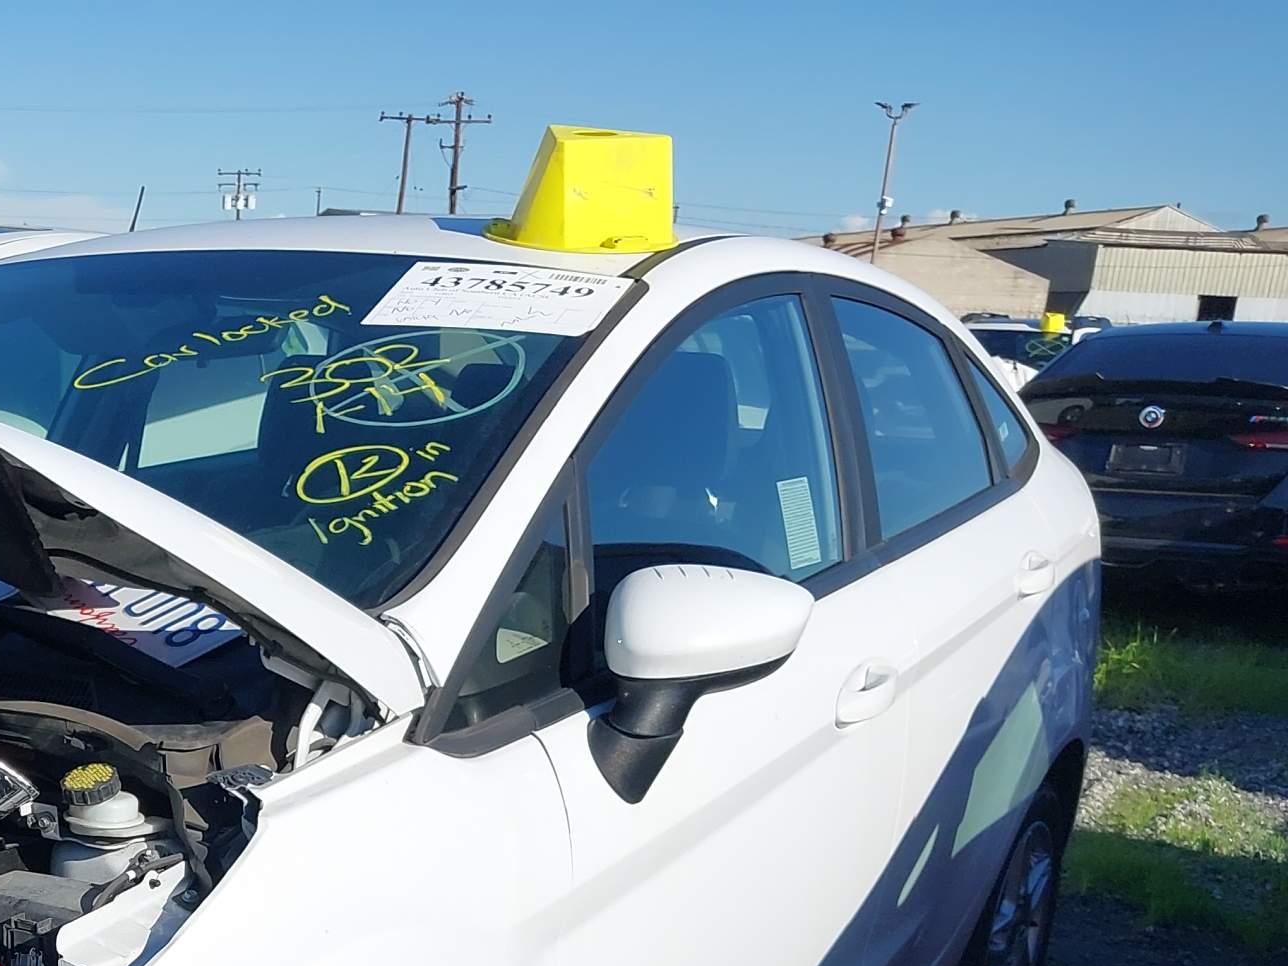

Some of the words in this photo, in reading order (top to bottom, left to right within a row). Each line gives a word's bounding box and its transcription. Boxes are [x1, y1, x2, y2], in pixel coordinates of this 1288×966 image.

[421, 275, 596, 299] 43785749
[73, 343, 200, 391] Car
[192, 294, 352, 347] locked
